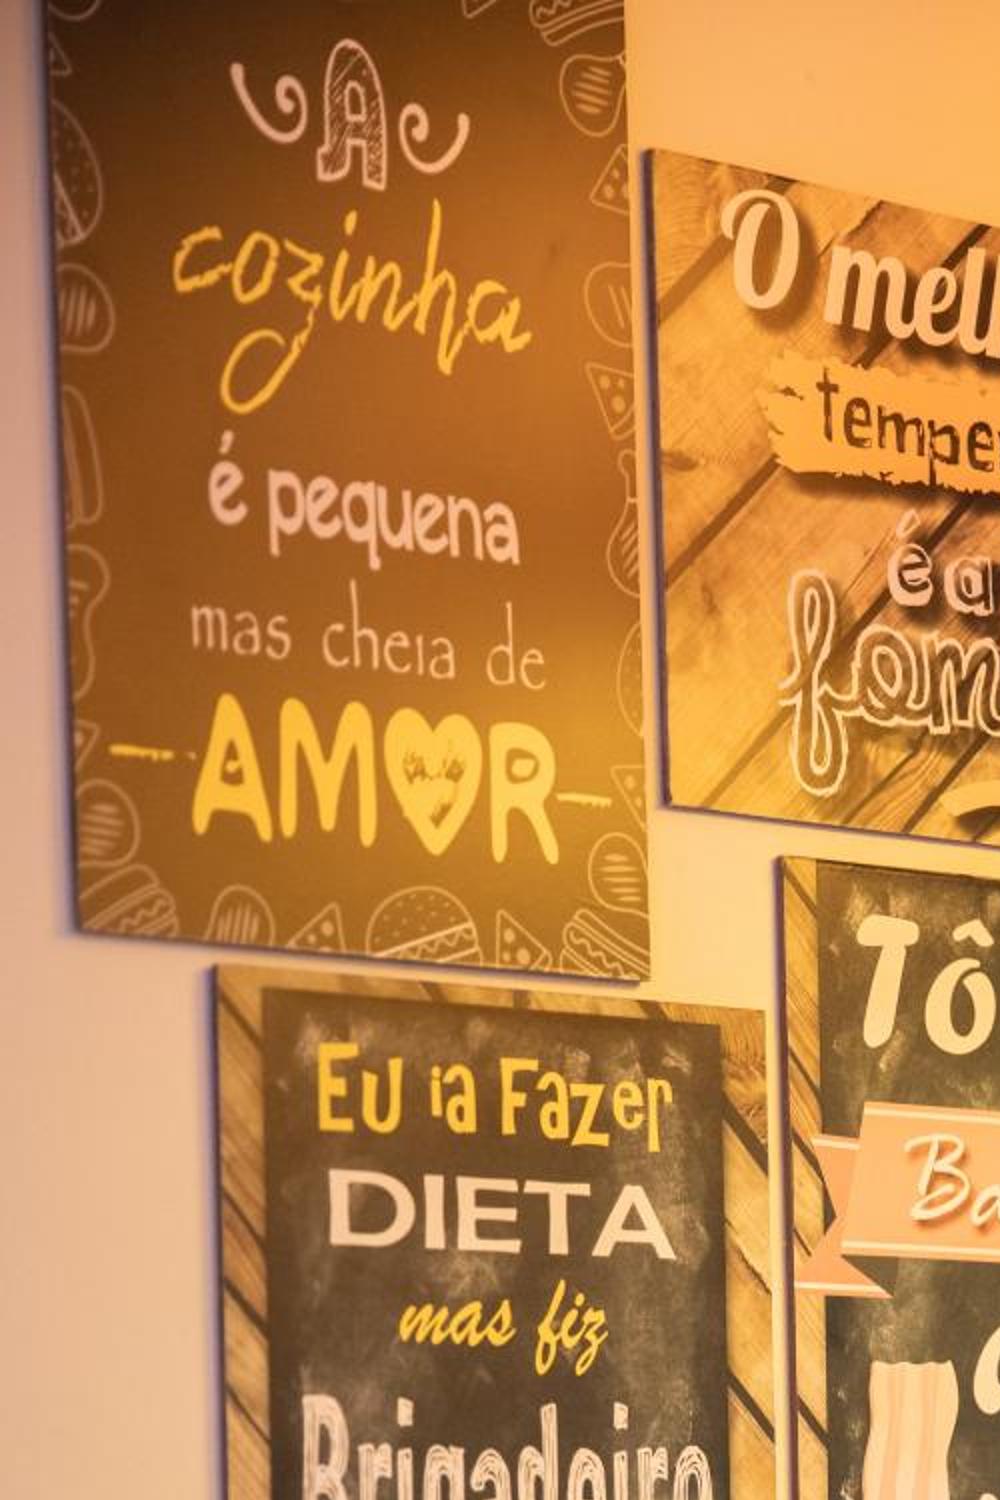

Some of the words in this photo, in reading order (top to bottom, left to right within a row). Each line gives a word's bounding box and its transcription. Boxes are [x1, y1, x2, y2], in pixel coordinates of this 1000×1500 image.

[172, 198, 532, 414] cozinha
[720, 189, 801, 311] O
[208, 430, 249, 525] é
[268, 468, 520, 571] pequena
[888, 509, 933, 607] é
[944, 556, 994, 616] a
[191, 604, 292, 659] mas
[322, 578, 457, 682] cheia
[486, 602, 546, 690] de
[856, 914, 997, 1055] Tô
[430, 1064, 478, 1134] ia
[500, 1057, 673, 1152] Fazer
[328, 1168, 677, 1260] DIETA
[400, 1299, 516, 1347] mas
[535, 1279, 609, 1377] fiz
